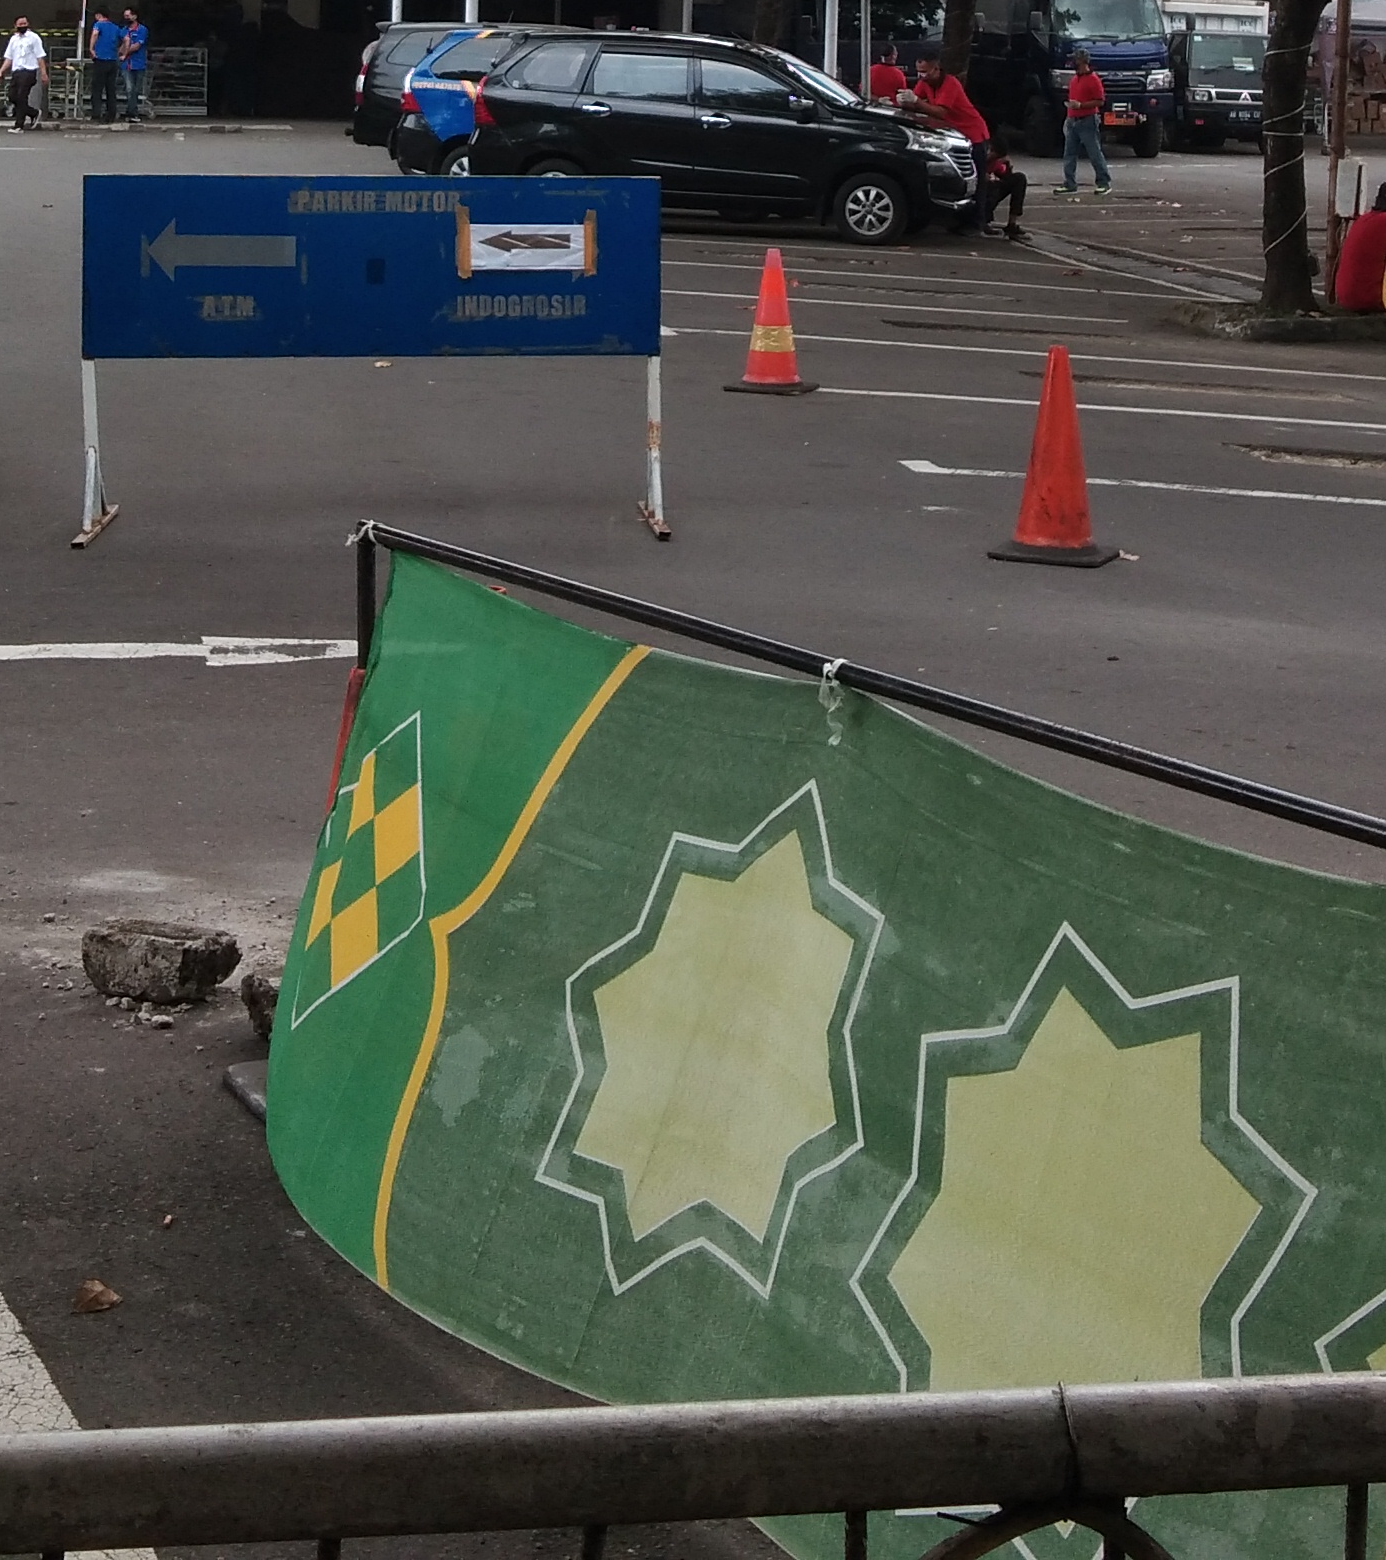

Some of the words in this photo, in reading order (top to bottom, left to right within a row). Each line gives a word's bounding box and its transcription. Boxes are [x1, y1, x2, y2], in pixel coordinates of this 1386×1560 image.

[297, 190, 376, 213] PARKIR
[385, 191, 461, 213] MOTOR
[203, 295, 255, 317] ATM
[456, 294, 586, 317] INDOGROSIR
